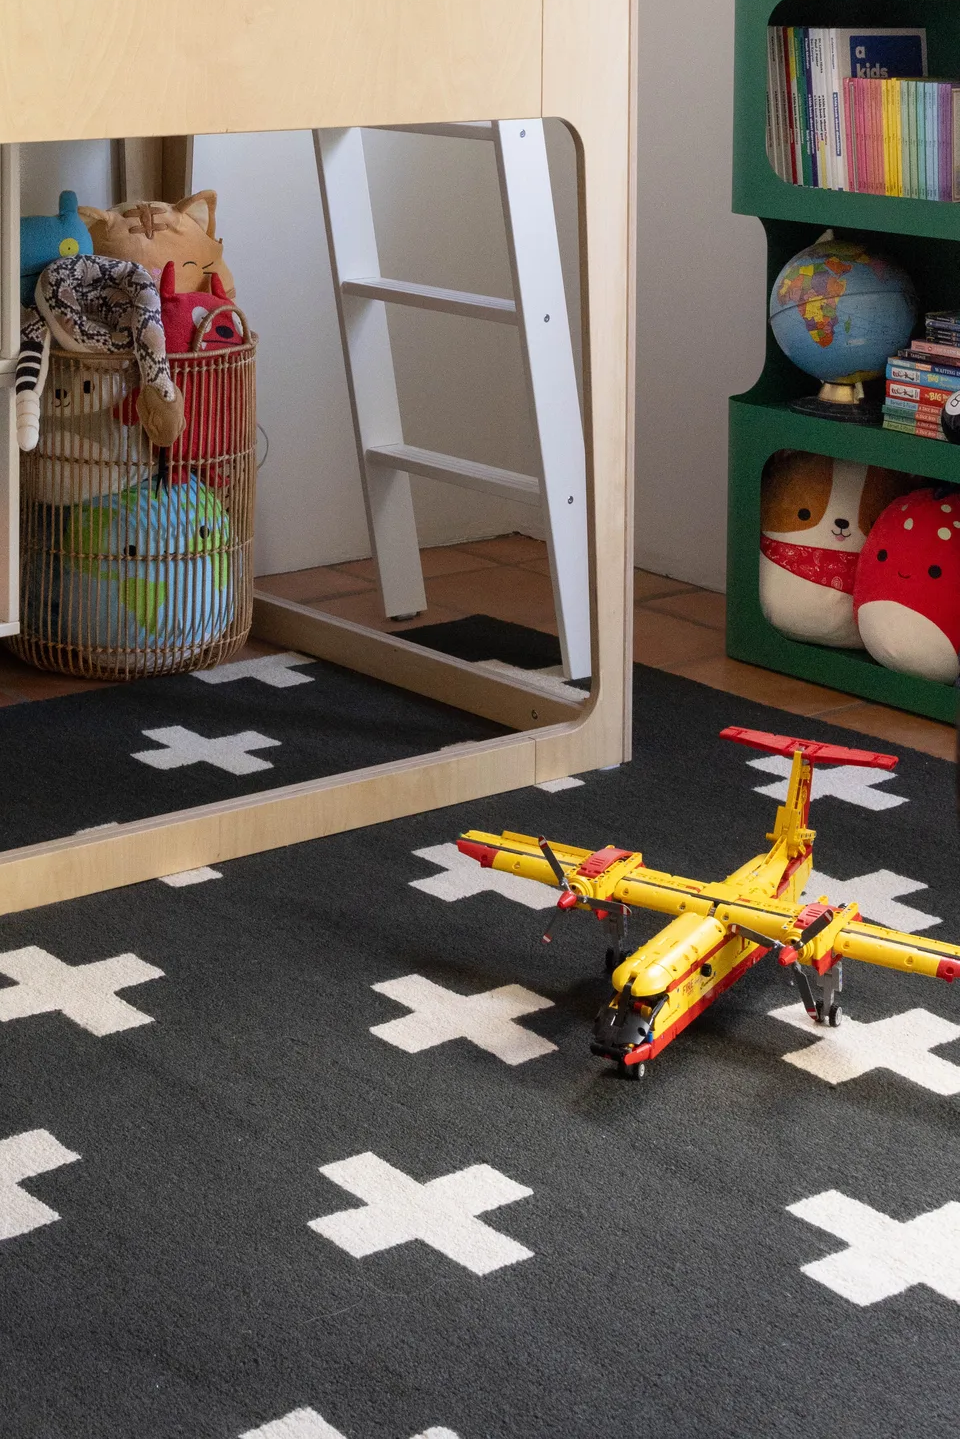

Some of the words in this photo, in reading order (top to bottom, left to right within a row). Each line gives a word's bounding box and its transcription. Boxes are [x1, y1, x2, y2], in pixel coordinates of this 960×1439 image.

[855, 46, 866, 58] a
[856, 63, 889, 77] kids
[929, 392, 941, 401] BIG
